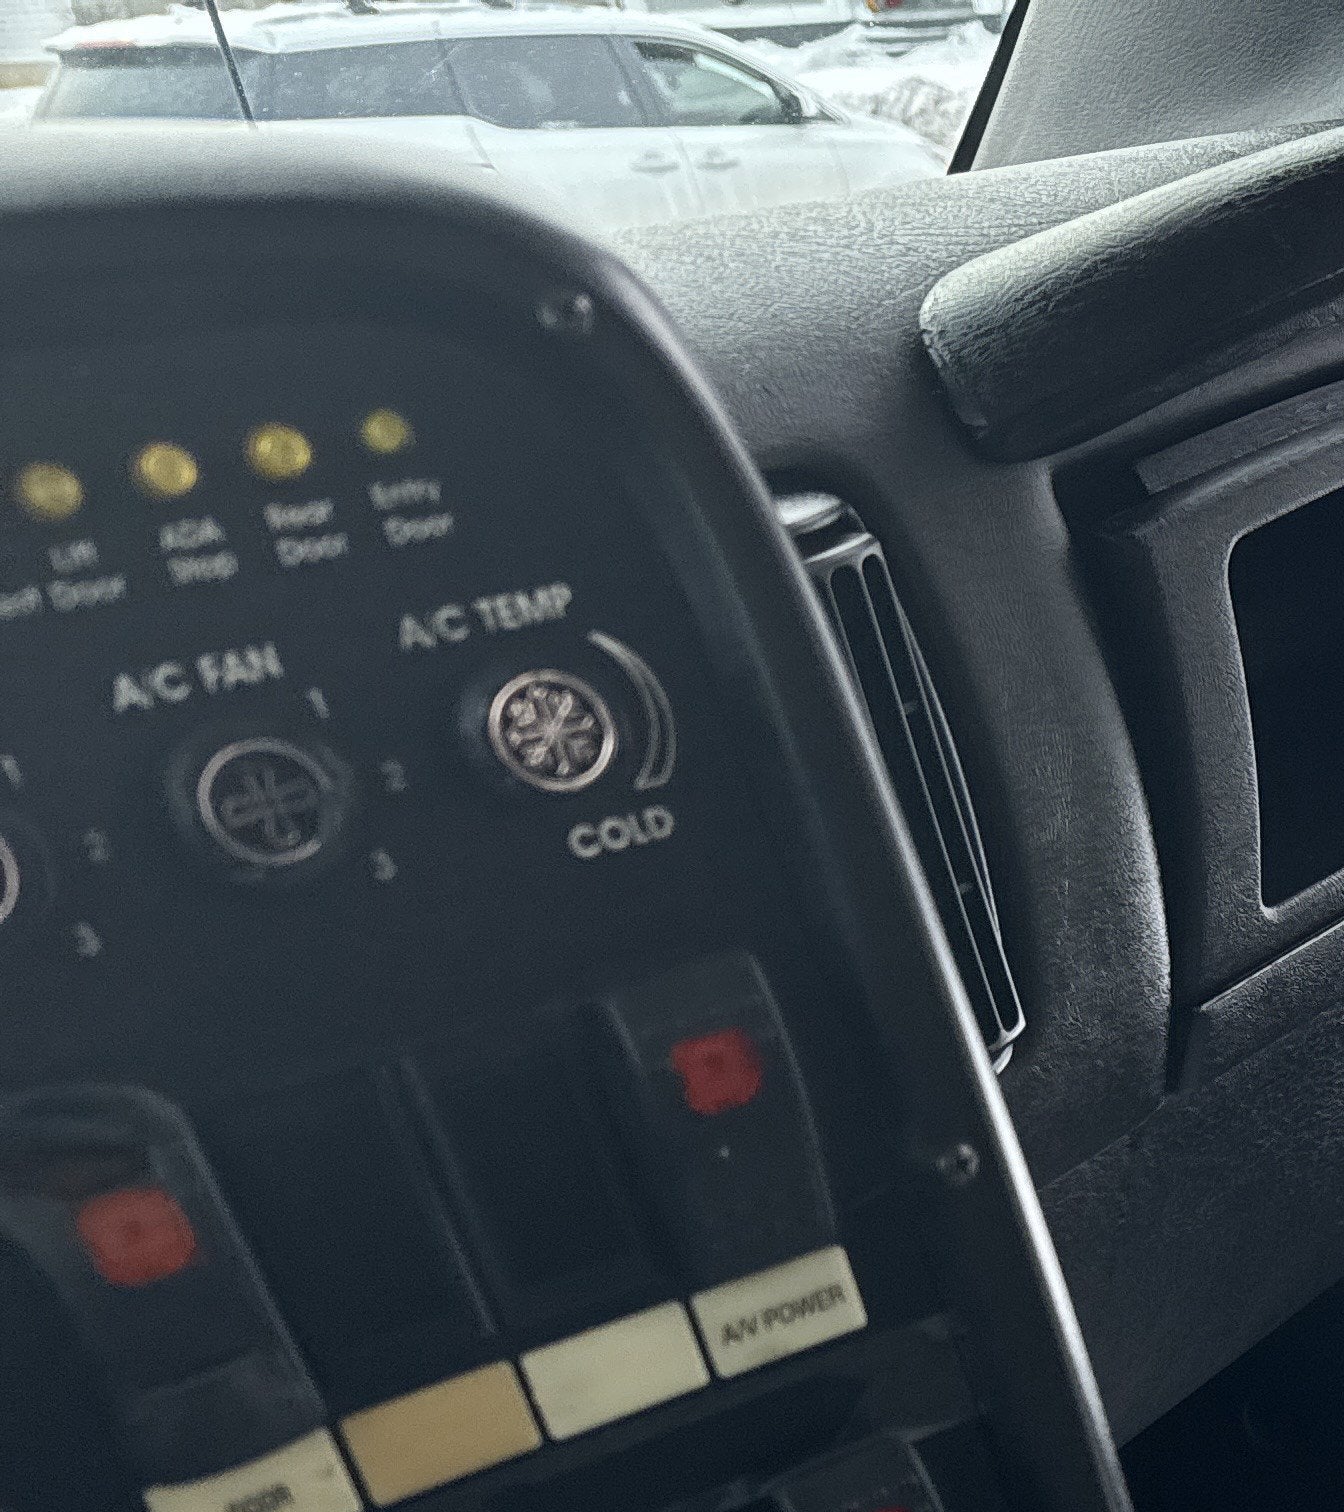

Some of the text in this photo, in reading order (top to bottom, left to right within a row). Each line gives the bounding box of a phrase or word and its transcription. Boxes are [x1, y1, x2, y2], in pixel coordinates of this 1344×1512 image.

[473, 581, 573, 634] TEMP
[197, 641, 284, 694] FAN
[567, 805, 676, 859] COLD
[761, 1283, 845, 1331] POWER
